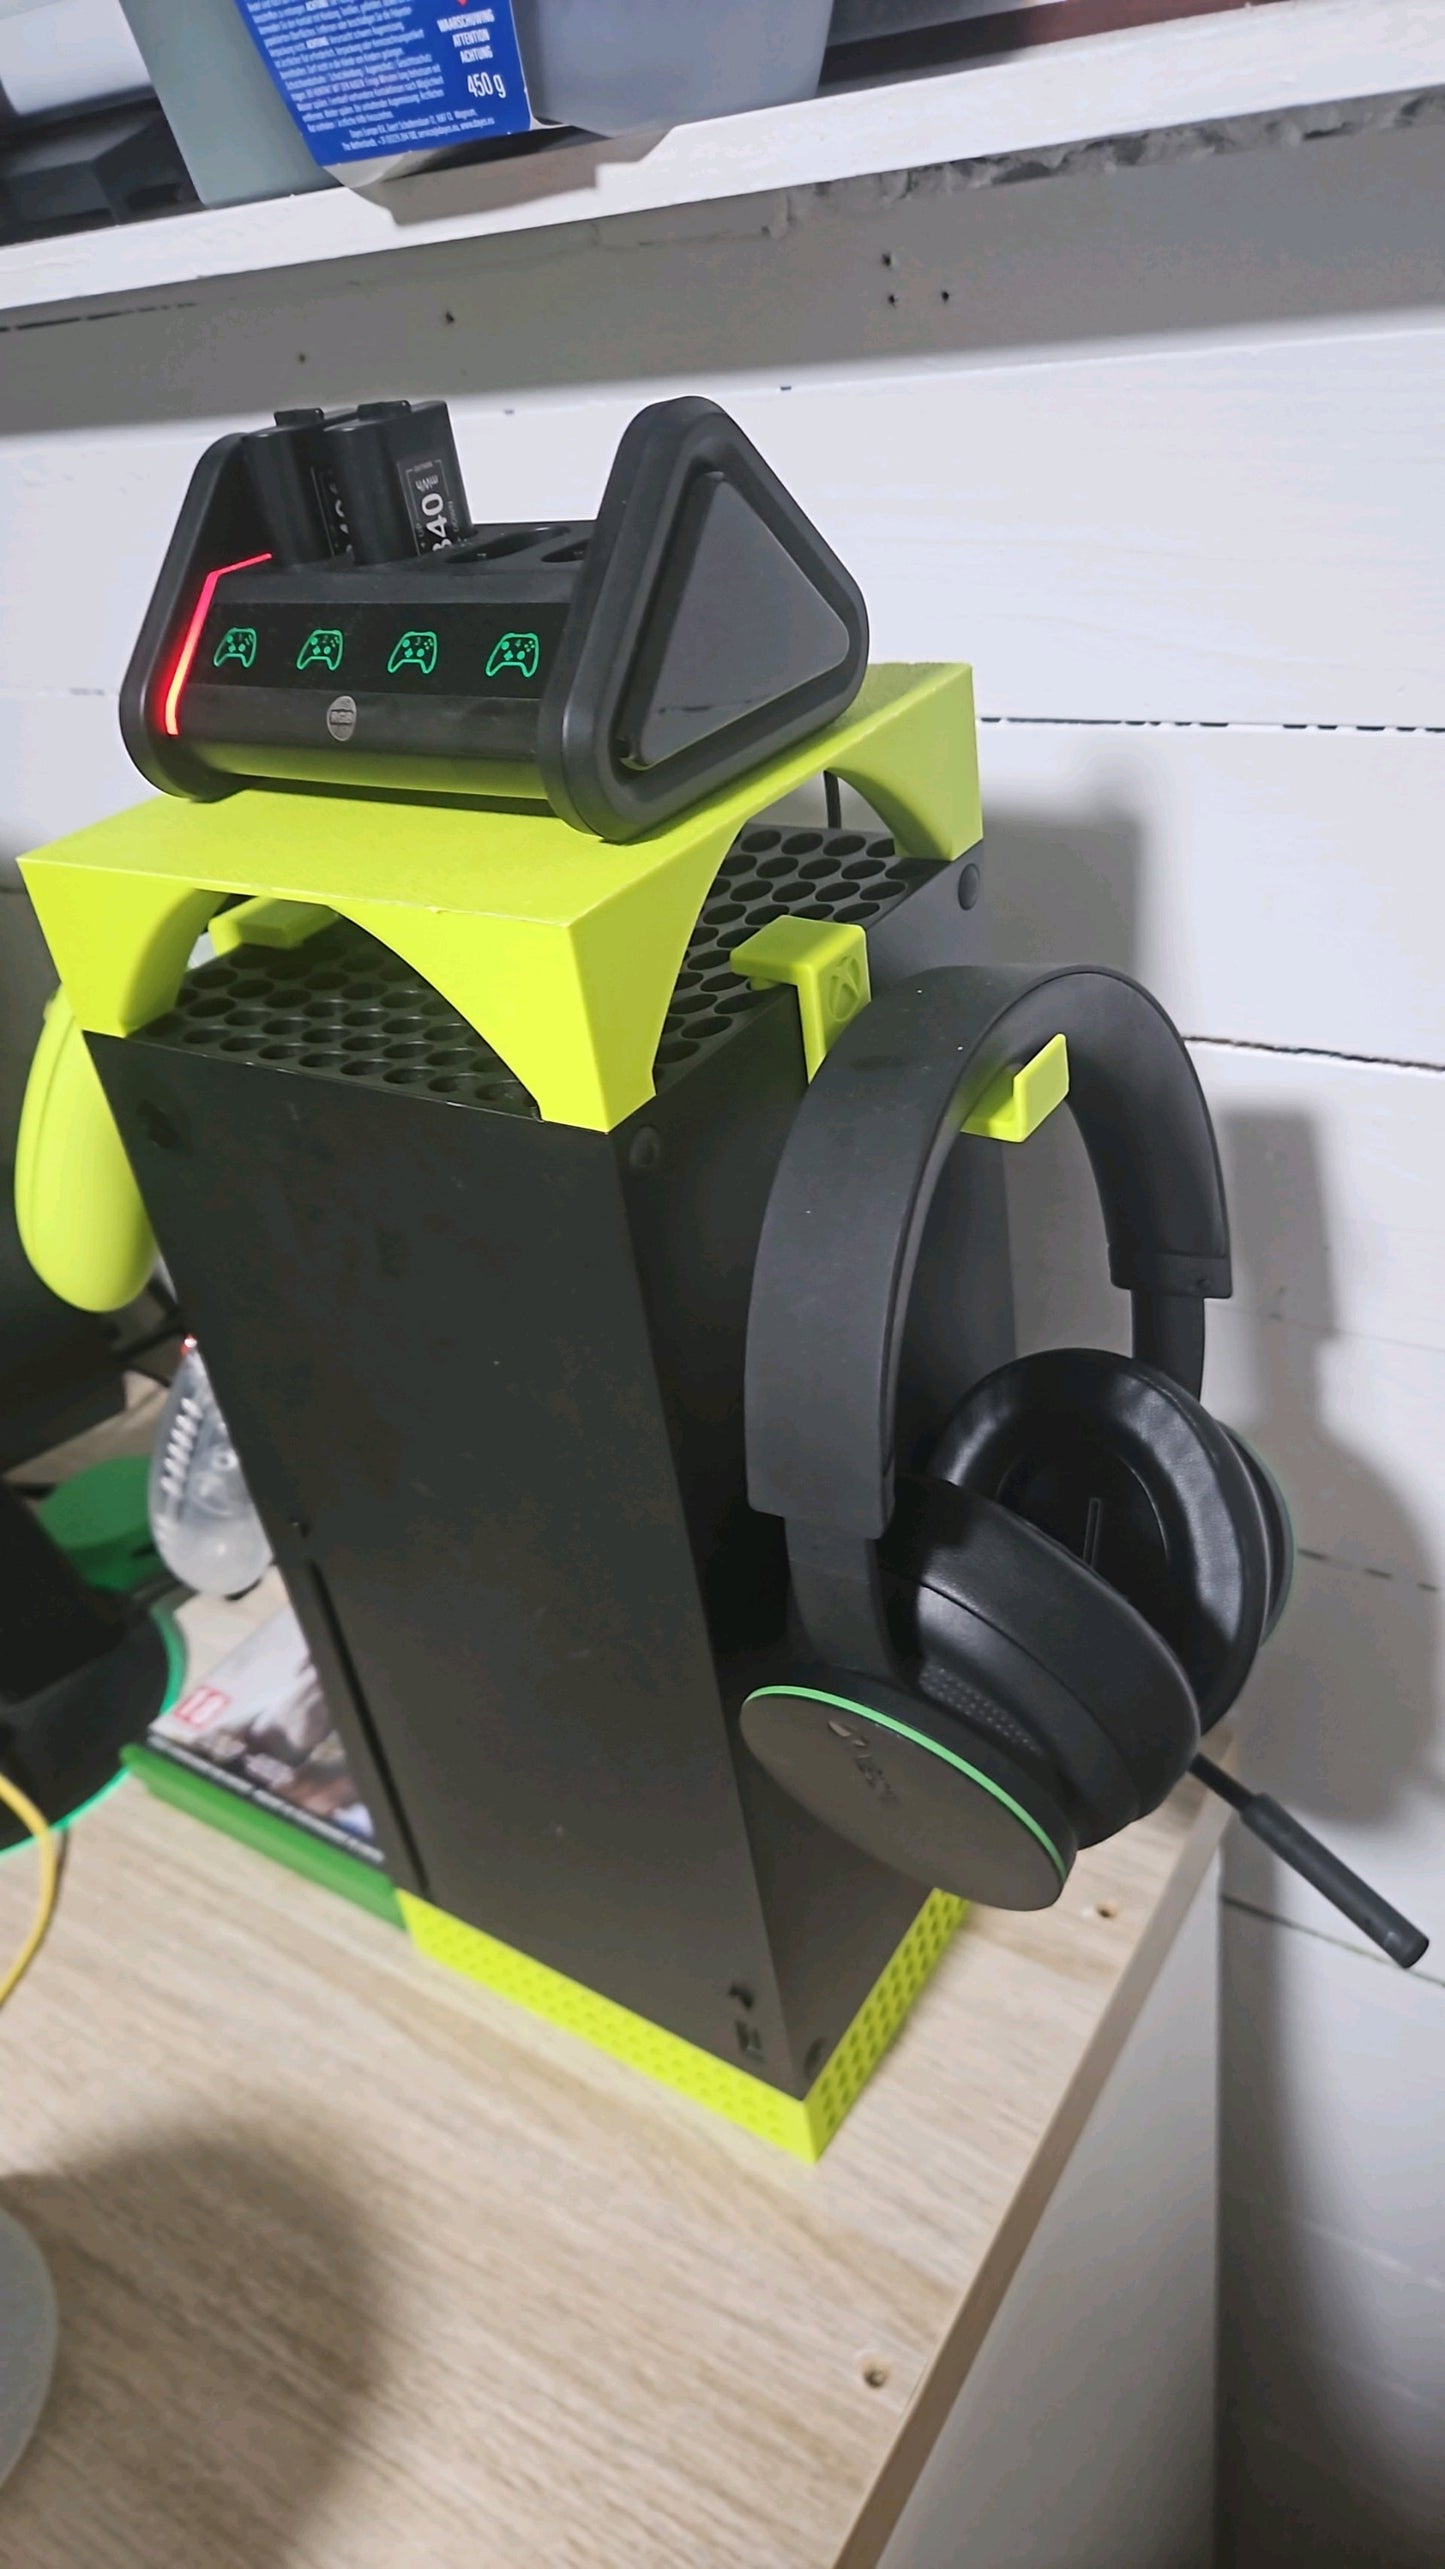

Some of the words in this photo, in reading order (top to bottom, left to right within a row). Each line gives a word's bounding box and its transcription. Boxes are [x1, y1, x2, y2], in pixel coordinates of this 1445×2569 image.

[452, 28, 490, 48] ATTENTION
[460, 45, 493, 64] ACHTUNG
[467, 72, 494, 98] 450
[493, 74, 507, 99] g
